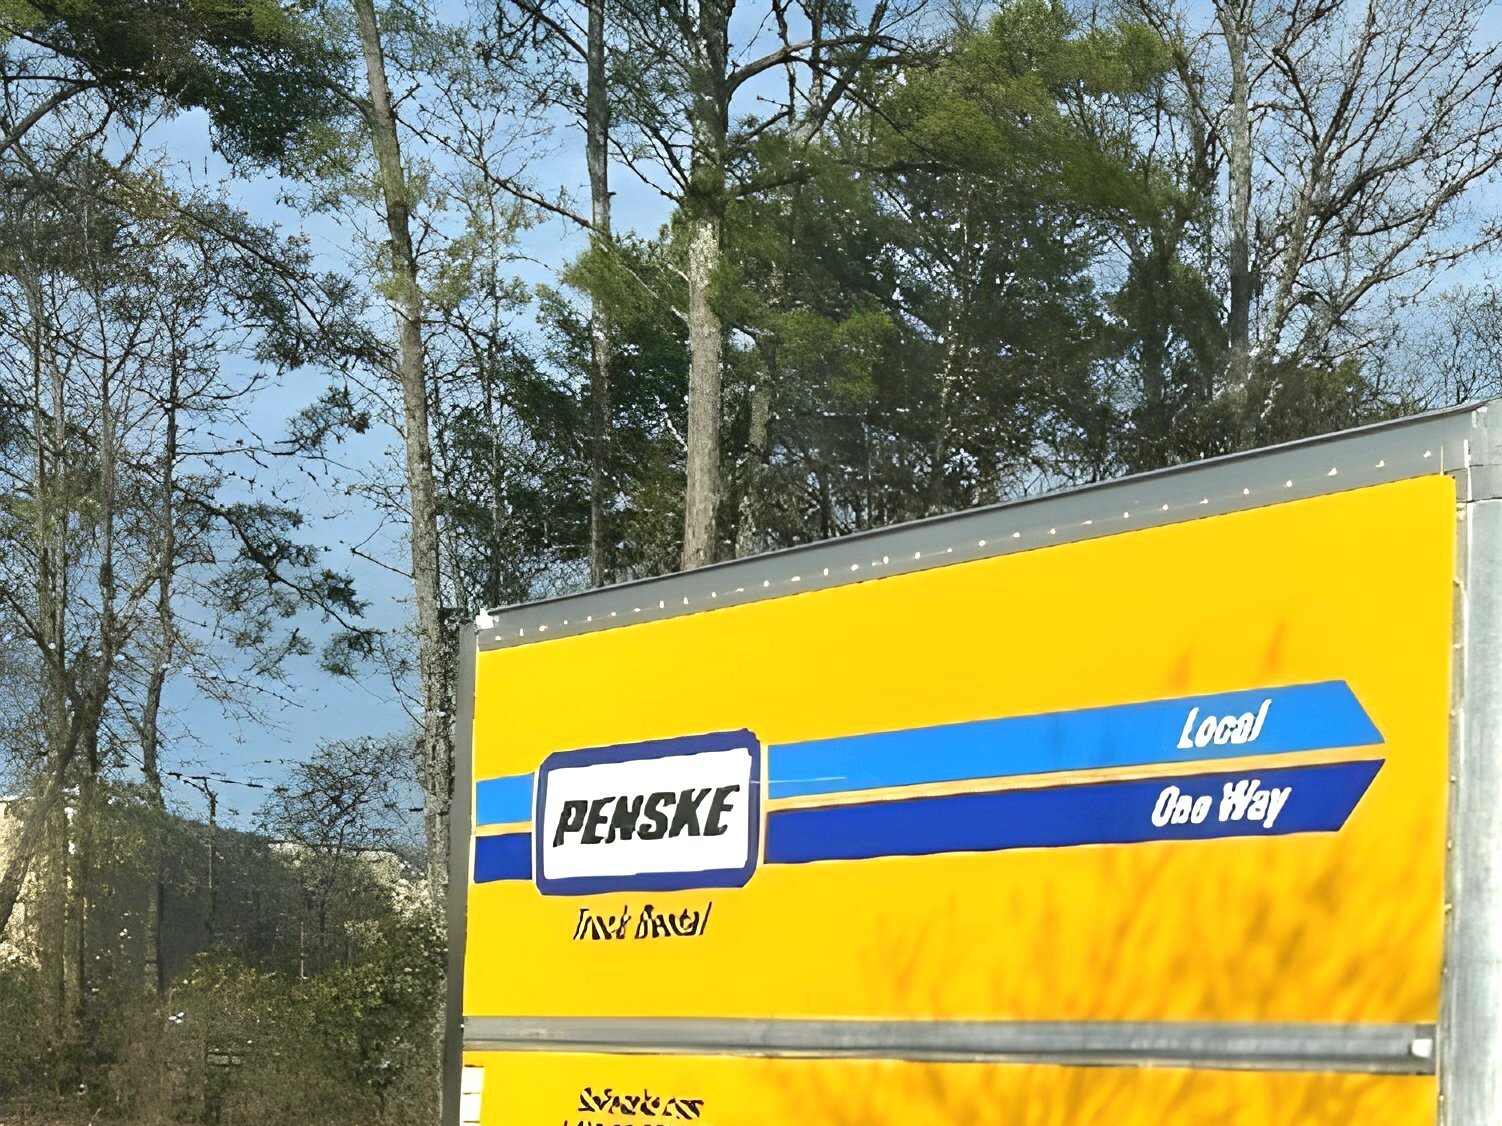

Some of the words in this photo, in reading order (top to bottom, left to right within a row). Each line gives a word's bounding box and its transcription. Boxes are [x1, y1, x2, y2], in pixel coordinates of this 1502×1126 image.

[1176, 698, 1272, 748] Local
[552, 783, 741, 848] PENSKE
[1218, 779, 1292, 829] Way
